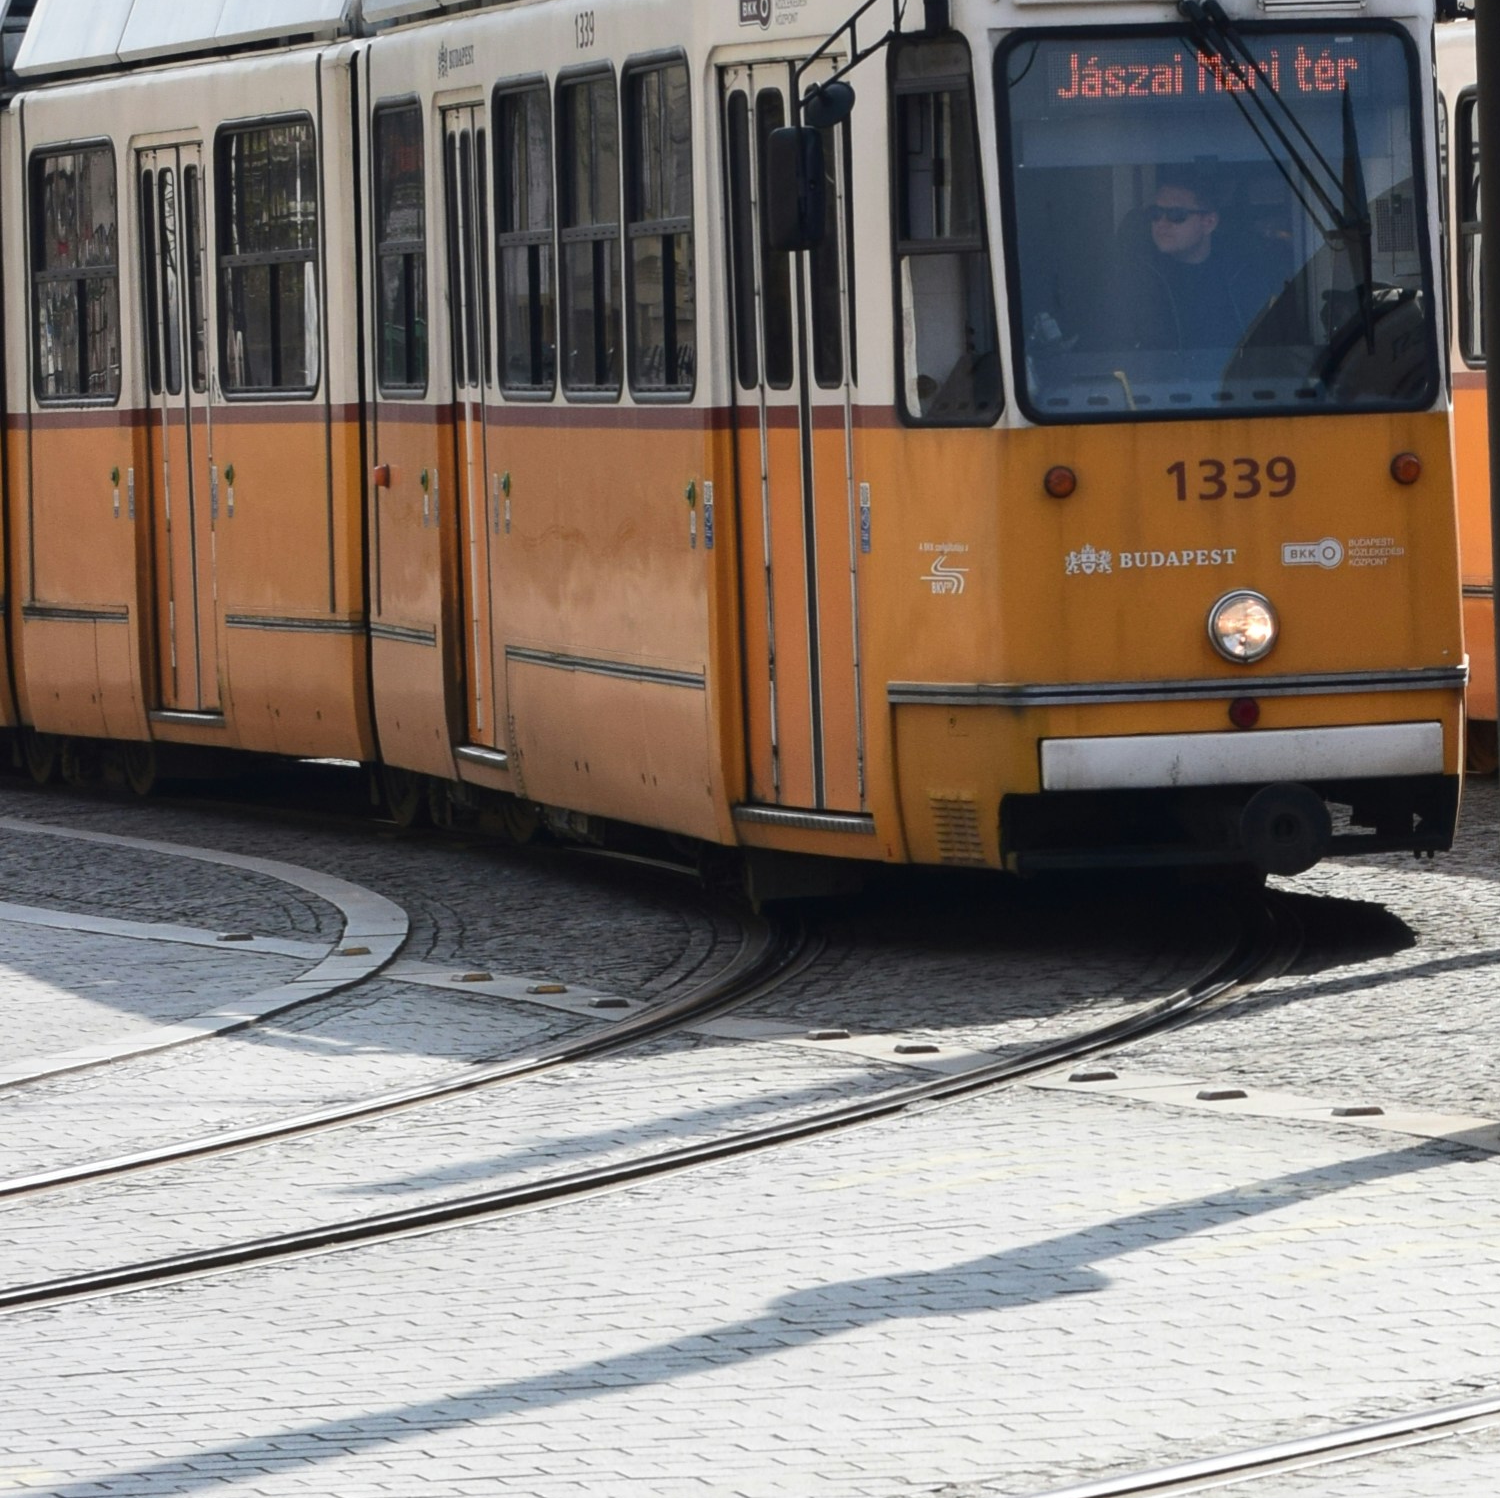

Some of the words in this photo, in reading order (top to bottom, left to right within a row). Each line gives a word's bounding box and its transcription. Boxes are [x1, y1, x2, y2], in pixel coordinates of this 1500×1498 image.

[741, 1, 758, 17] BKK
[574, 10, 595, 49] 1339
[448, 44, 475, 70] BUDAPEST
[1057, 52, 1183, 100] Jászai
[1196, 50, 1281, 94] Mari
[1294, 45, 1358, 92] tér
[1166, 455, 1298, 503] 1339
[1290, 549, 1316, 559] BKK
[1348, 537, 1394, 547] BUDAPESTI
[1119, 547, 1237, 569] BUDAPEST
